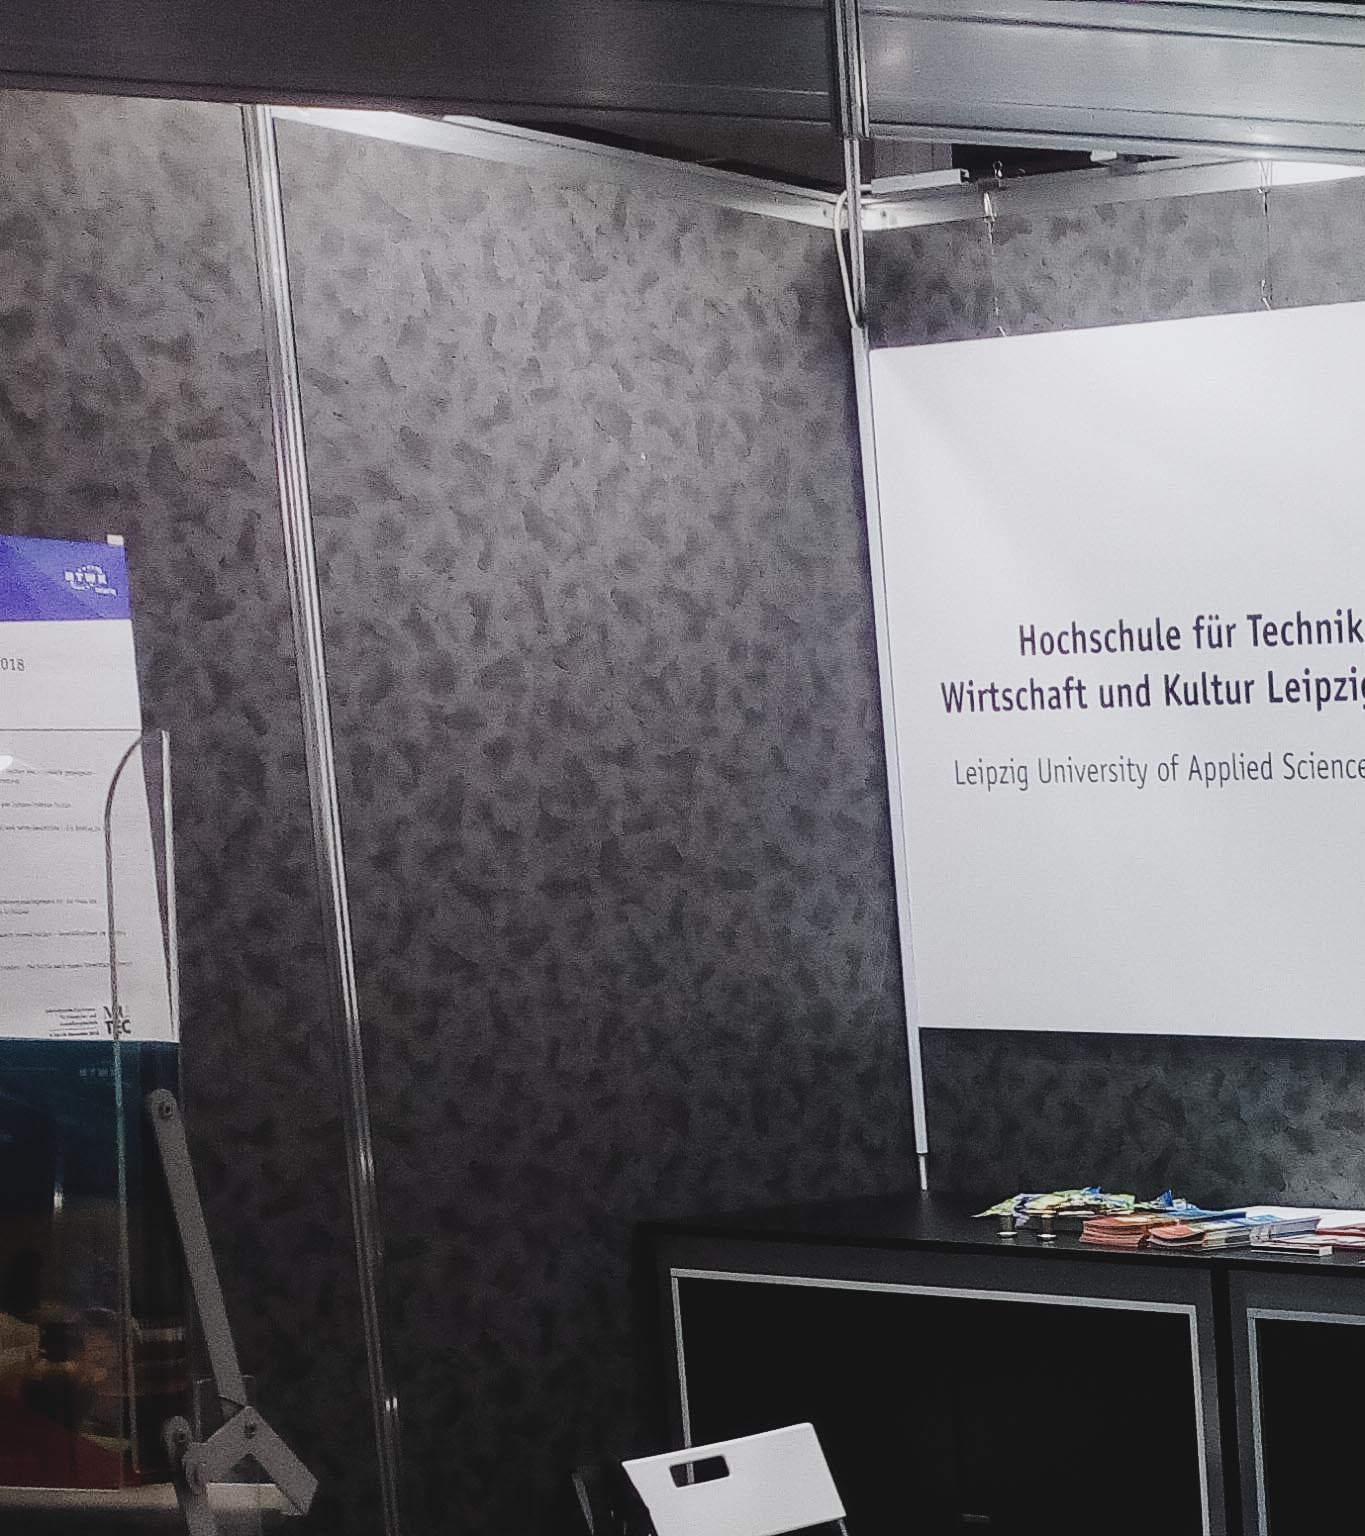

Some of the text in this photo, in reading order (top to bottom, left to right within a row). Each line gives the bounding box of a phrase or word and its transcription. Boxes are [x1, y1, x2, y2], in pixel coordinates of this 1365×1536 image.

[1019, 617, 1181, 656] Hochschule
[1193, 615, 1236, 649] für
[940, 676, 1087, 713] Wirtschaft
[1099, 674, 1150, 708] und
[1164, 671, 1254, 706] Kultur
[954, 758, 1029, 792] Leipzig
[1038, 755, 1148, 788] University
[1157, 754, 1179, 782] of
[1188, 752, 1273, 788] Applied
